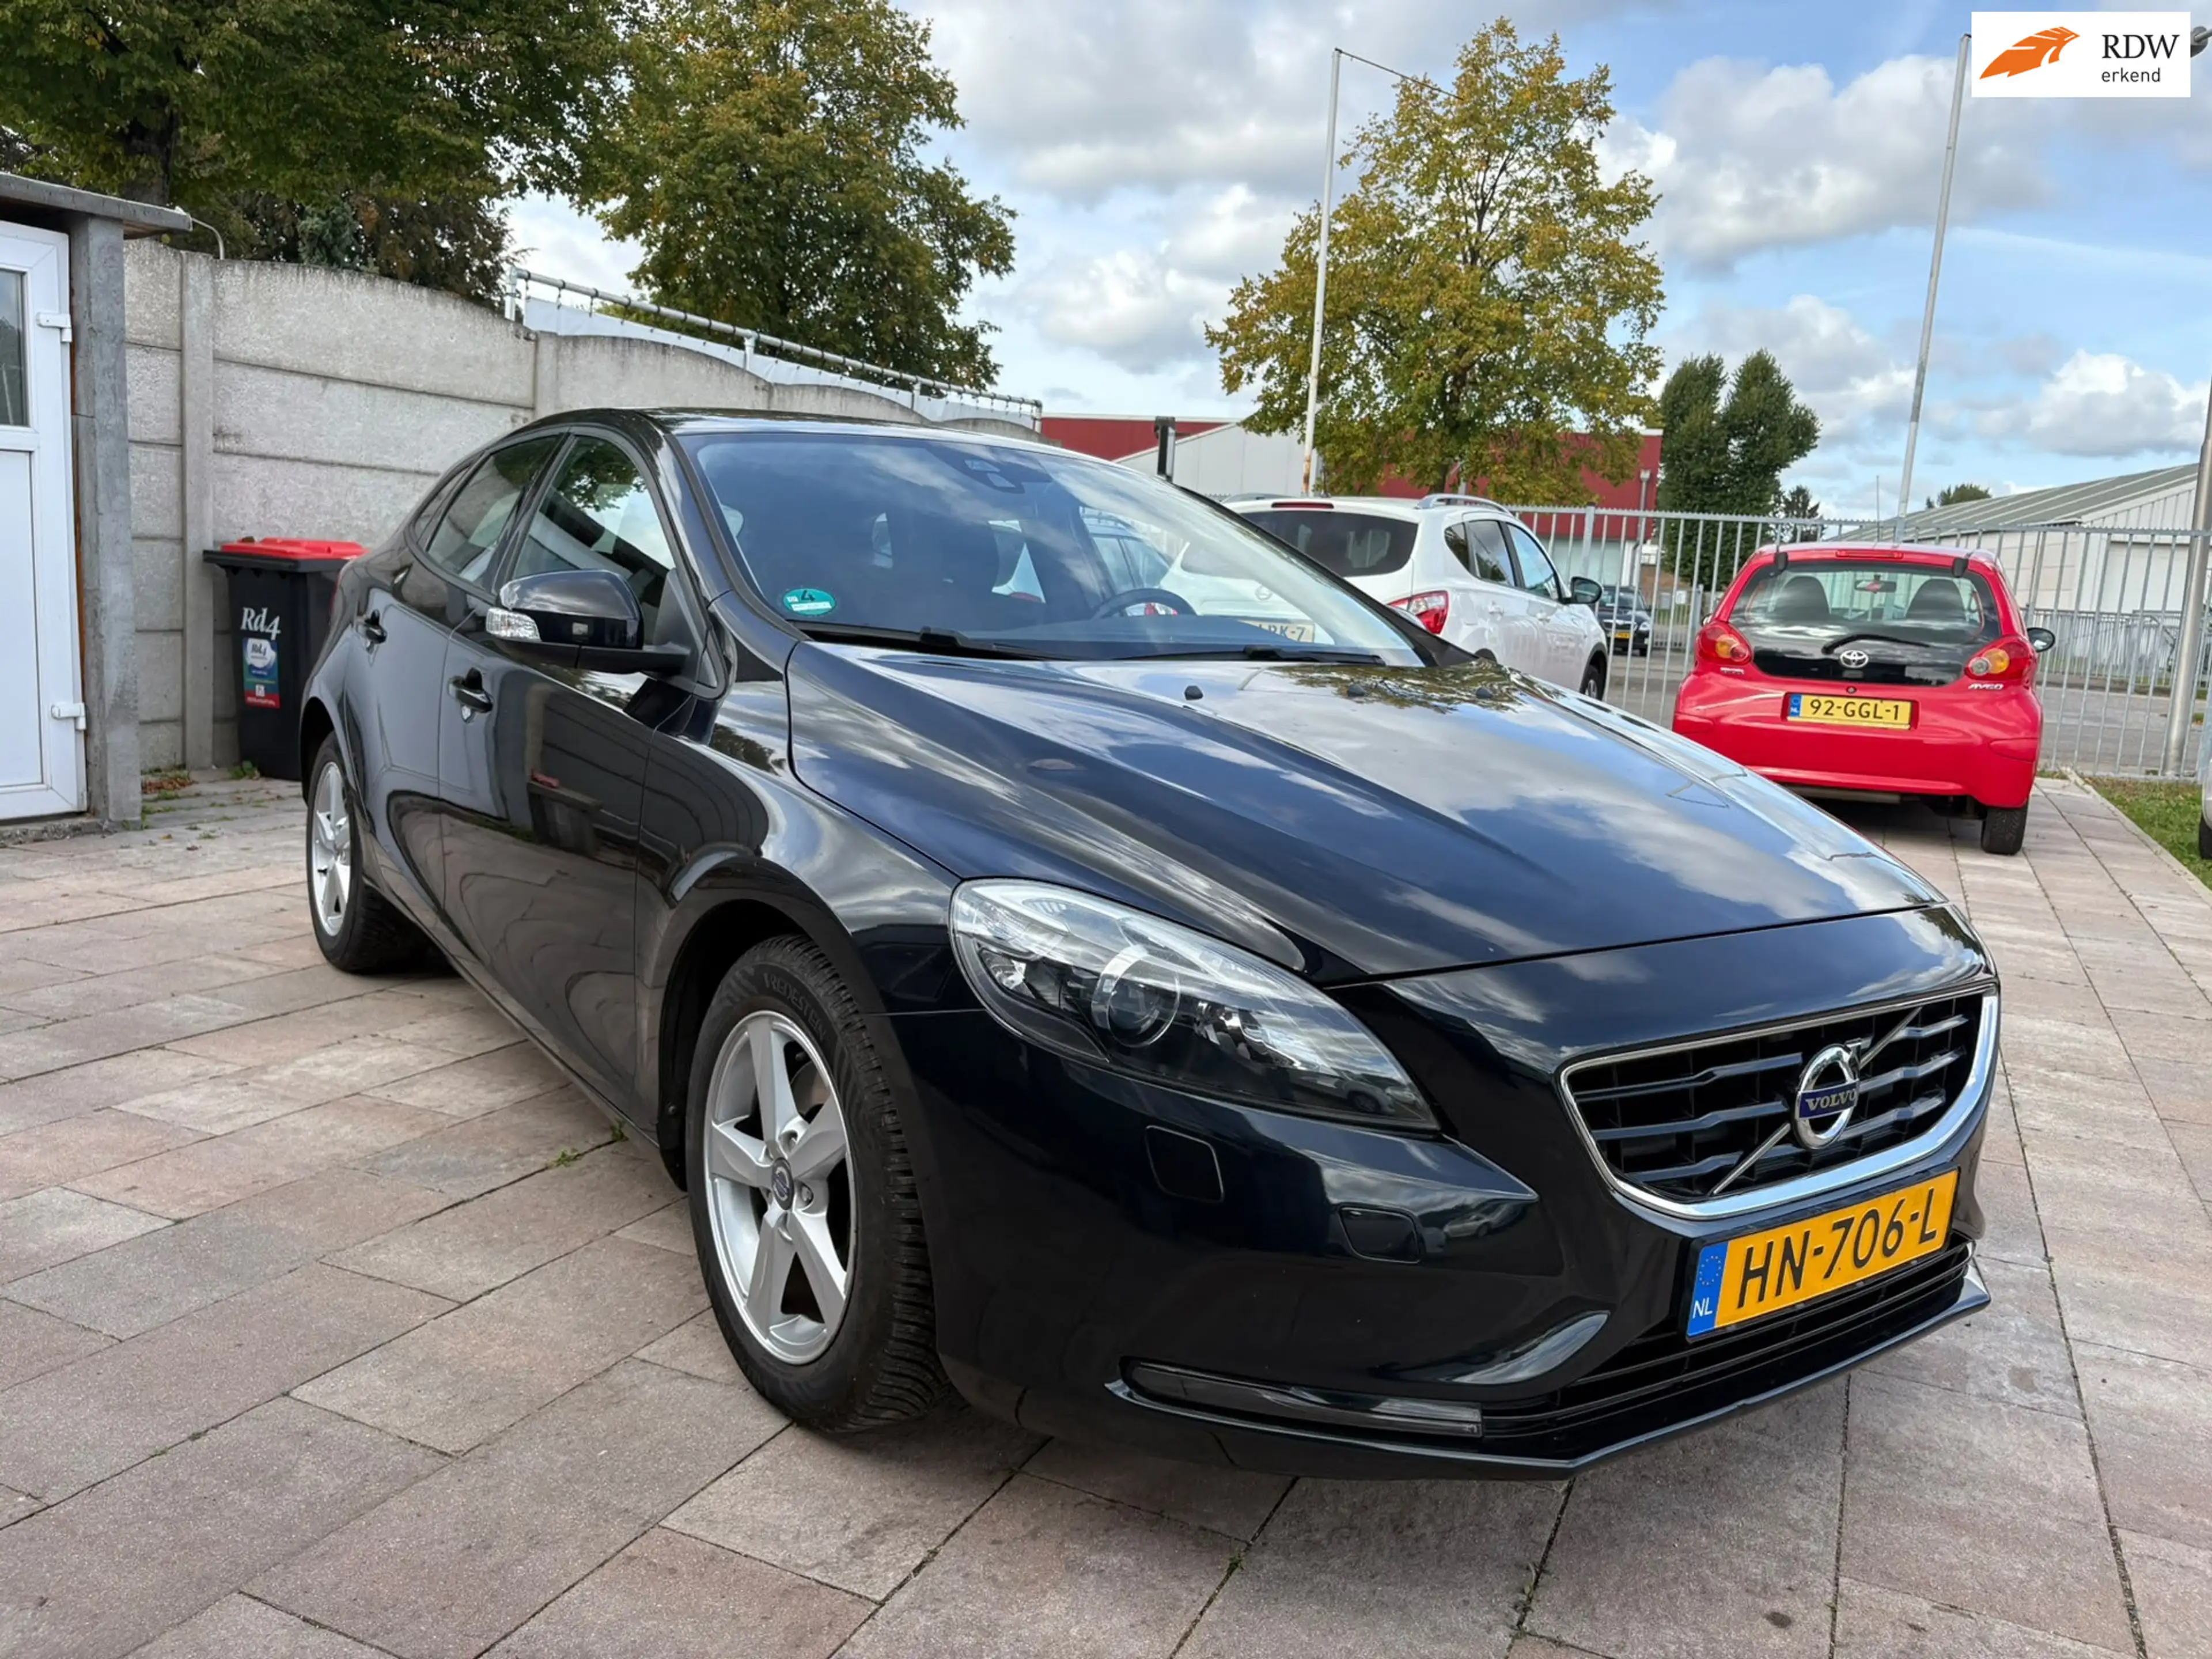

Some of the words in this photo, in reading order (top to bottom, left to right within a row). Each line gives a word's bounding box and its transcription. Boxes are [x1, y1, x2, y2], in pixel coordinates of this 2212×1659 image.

[801, 589, 816, 601] 4
[240, 607, 282, 640] Rd4
[1810, 699, 1899, 720] 92-GGL-1
[1805, 1089, 1857, 1111] VOLVO
[1692, 1297, 1712, 1317] NL
[1737, 1188, 1937, 1309] HN-706-L
